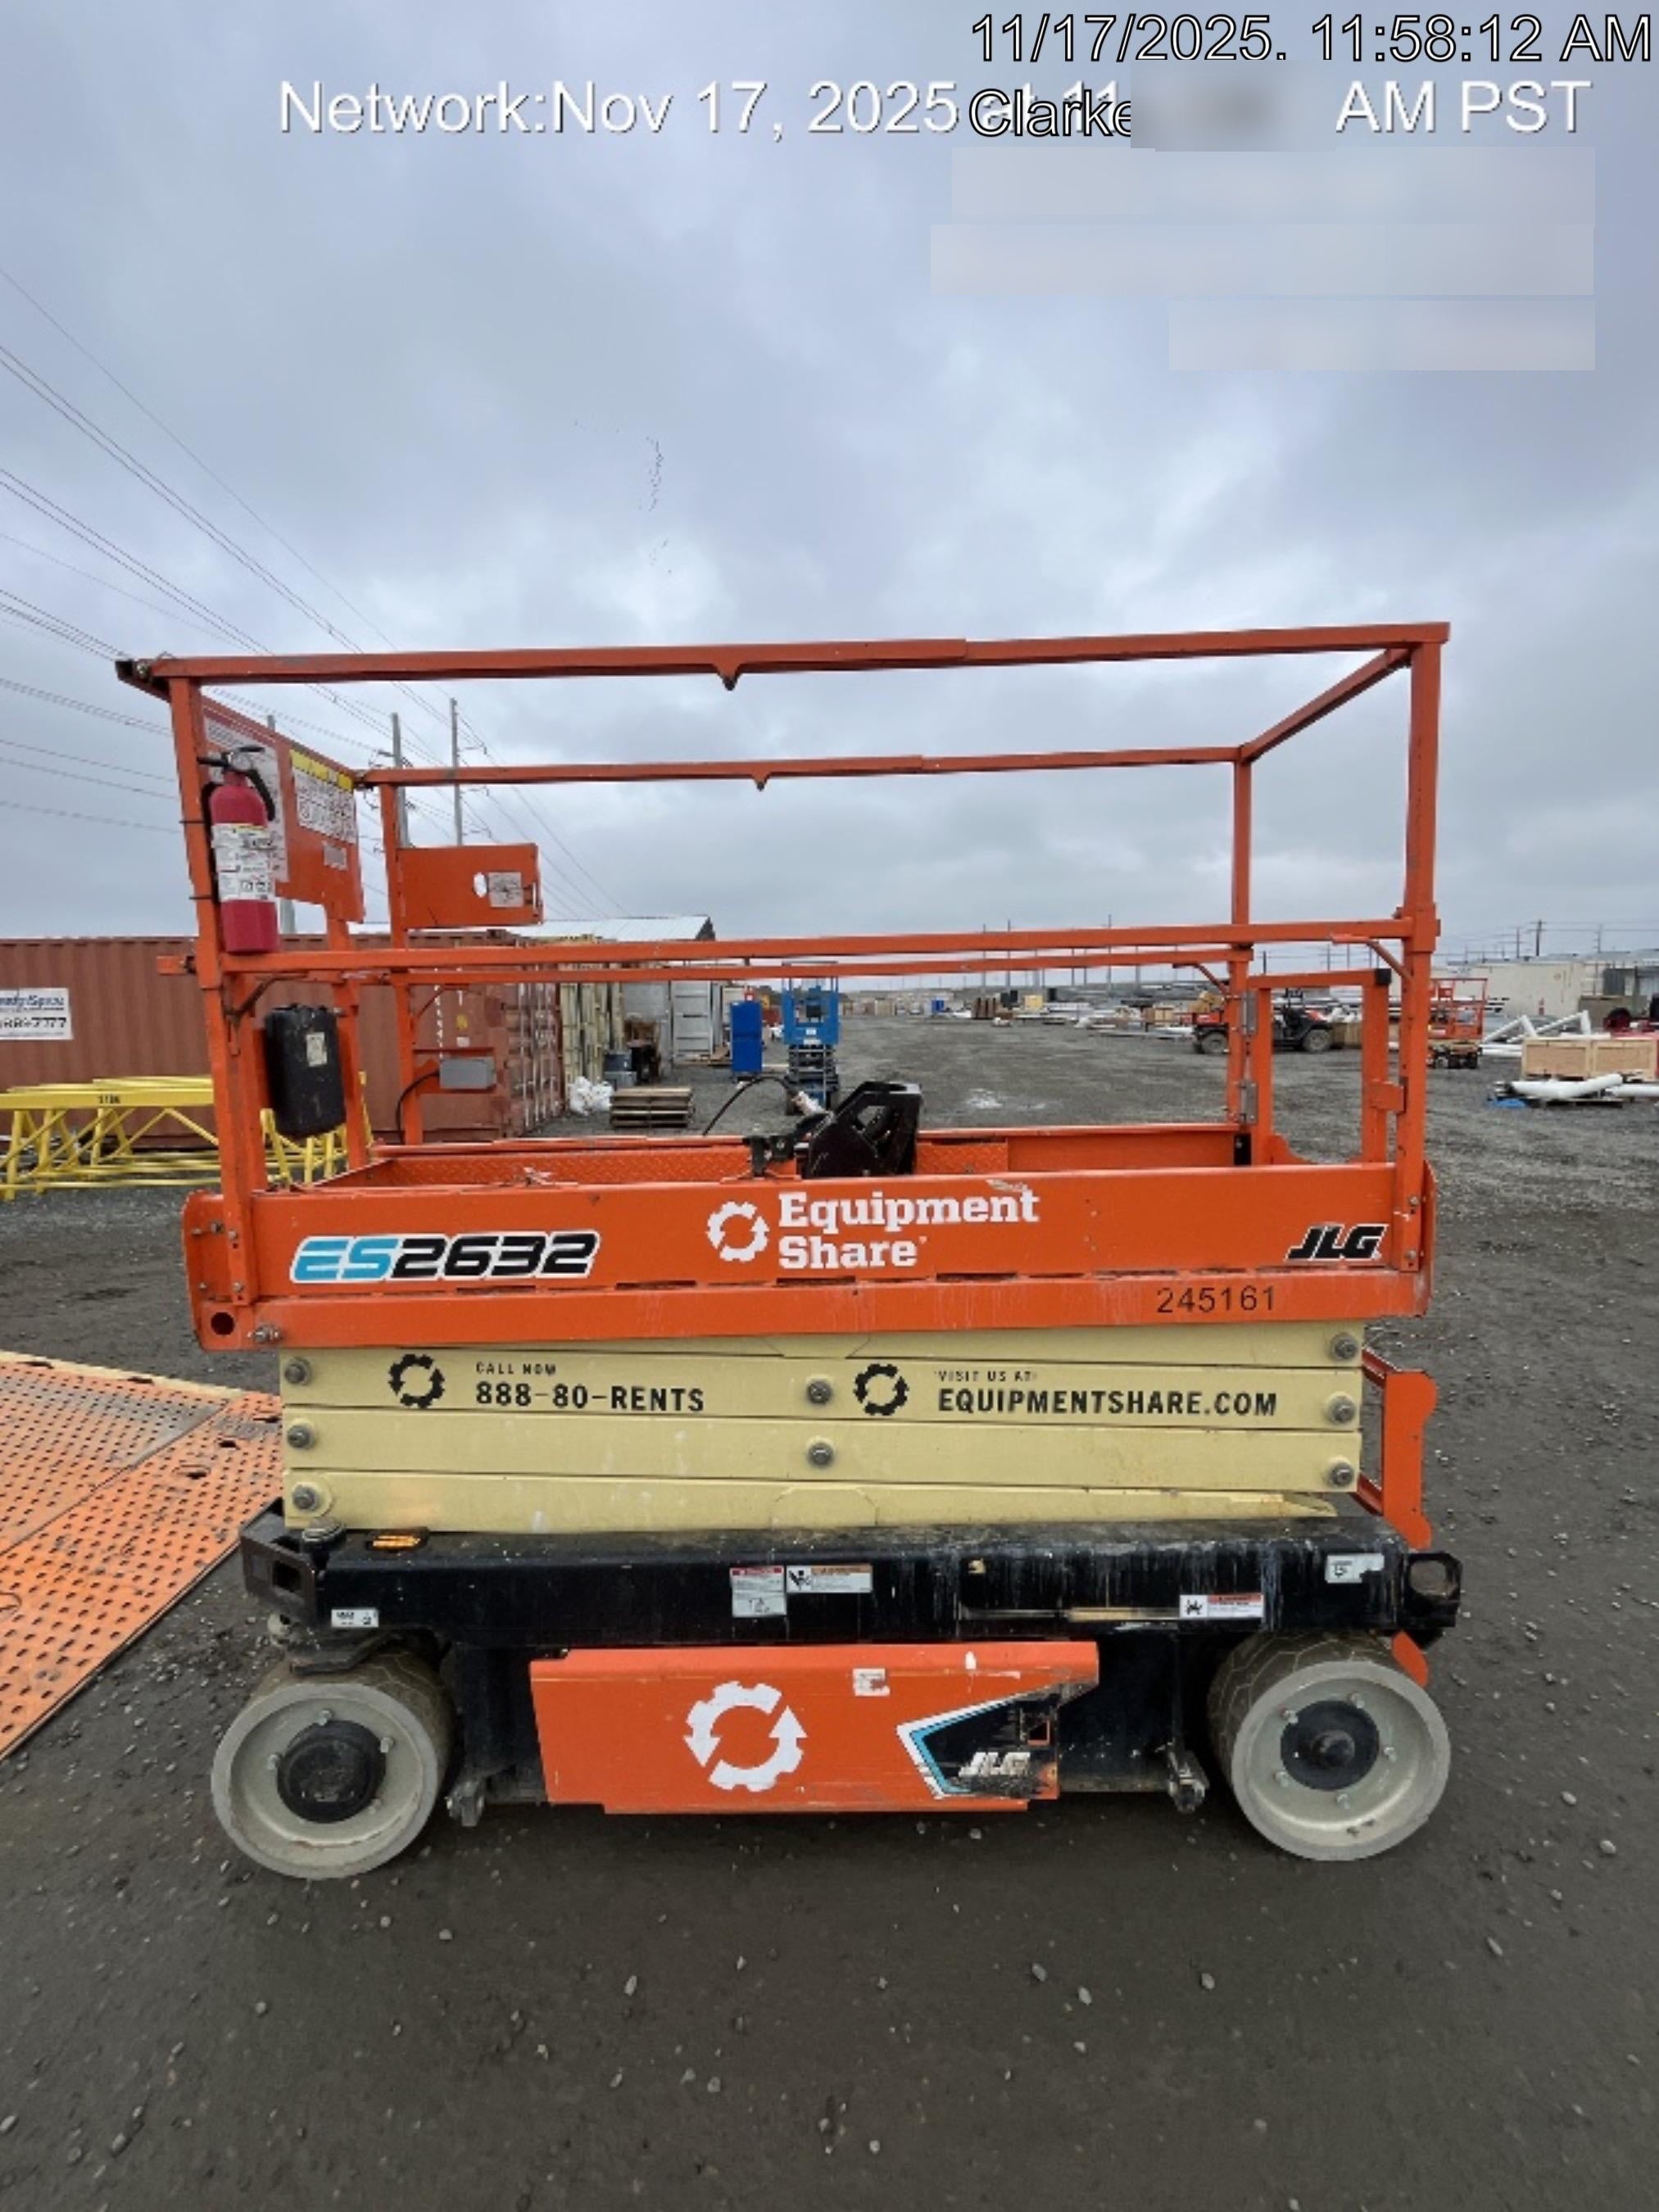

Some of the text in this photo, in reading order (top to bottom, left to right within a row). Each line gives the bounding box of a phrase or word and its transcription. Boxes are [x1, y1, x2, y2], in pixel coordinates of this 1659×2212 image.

[778, 1190, 1040, 1235] Equipment
[292, 1231, 599, 1283] ES2632
[778, 1235, 918, 1270] Share
[1284, 1223, 1389, 1262] JLG
[1156, 1285, 1275, 1313] 245161
[475, 1361, 556, 1376] CALL NOW
[937, 1370, 980, 1383] VISIT
[986, 1370, 1007, 1383] US
[475, 1380, 705, 1412] 888-80-RENTS
[937, 1388, 1277, 1416] EQUIPMENTSHARE.COM
[958, 1752, 1031, 1777] JLG
